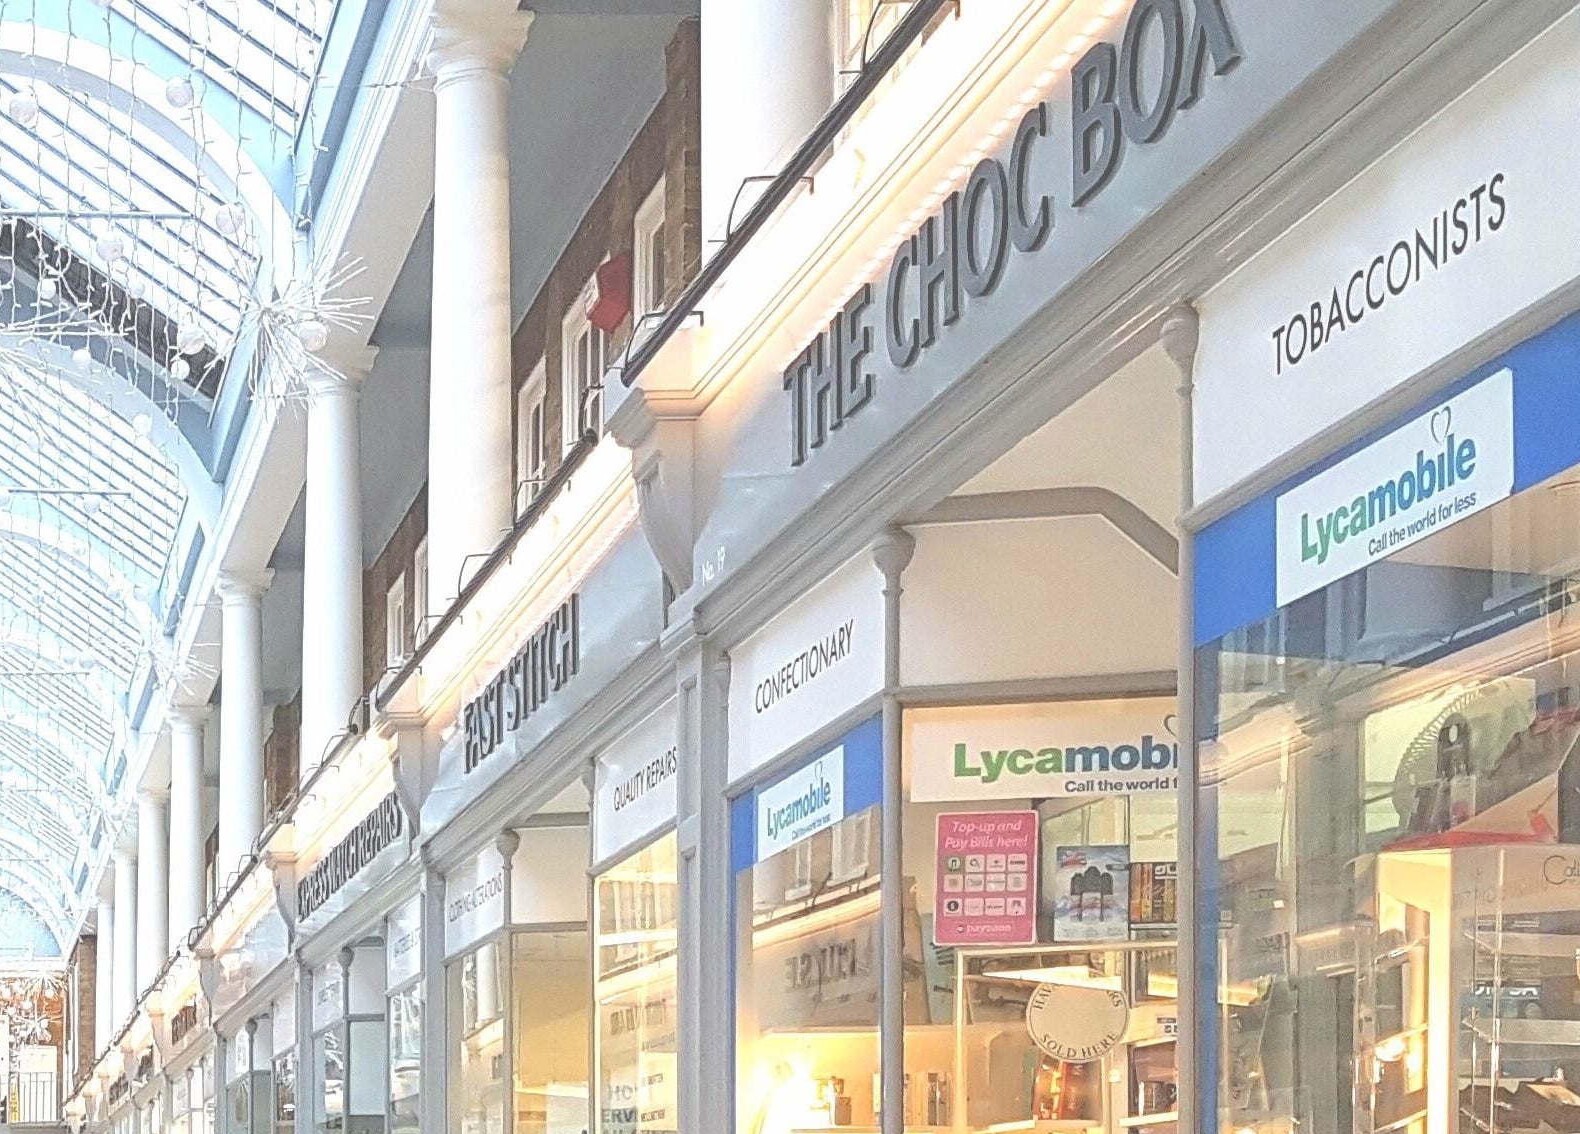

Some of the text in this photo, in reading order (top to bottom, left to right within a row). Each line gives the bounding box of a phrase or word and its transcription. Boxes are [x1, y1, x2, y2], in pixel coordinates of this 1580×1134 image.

[783, 283, 875, 467] THE
[884, 100, 1055, 368] CHOC
[1271, 173, 1508, 375] TOBACCONISTS
[1301, 433, 1476, 564] Lycamobile
[1368, 492, 1476, 556] Call the world for less
[464, 592, 580, 774] FAST STITCH
[754, 618, 855, 715] CONFECTIONARY
[614, 745, 677, 812] QUALITY REPAIRS
[767, 776, 831, 840] Lycamobile
[1065, 780, 1094, 793] Call
[1097, 779, 1123, 791] the
[1125, 776, 1169, 790] world
[944, 834, 1028, 850] Pay Bills here!
[952, 820, 1022, 833] Top-up and
[1039, 1032, 1119, 1059] SOLD HERE
